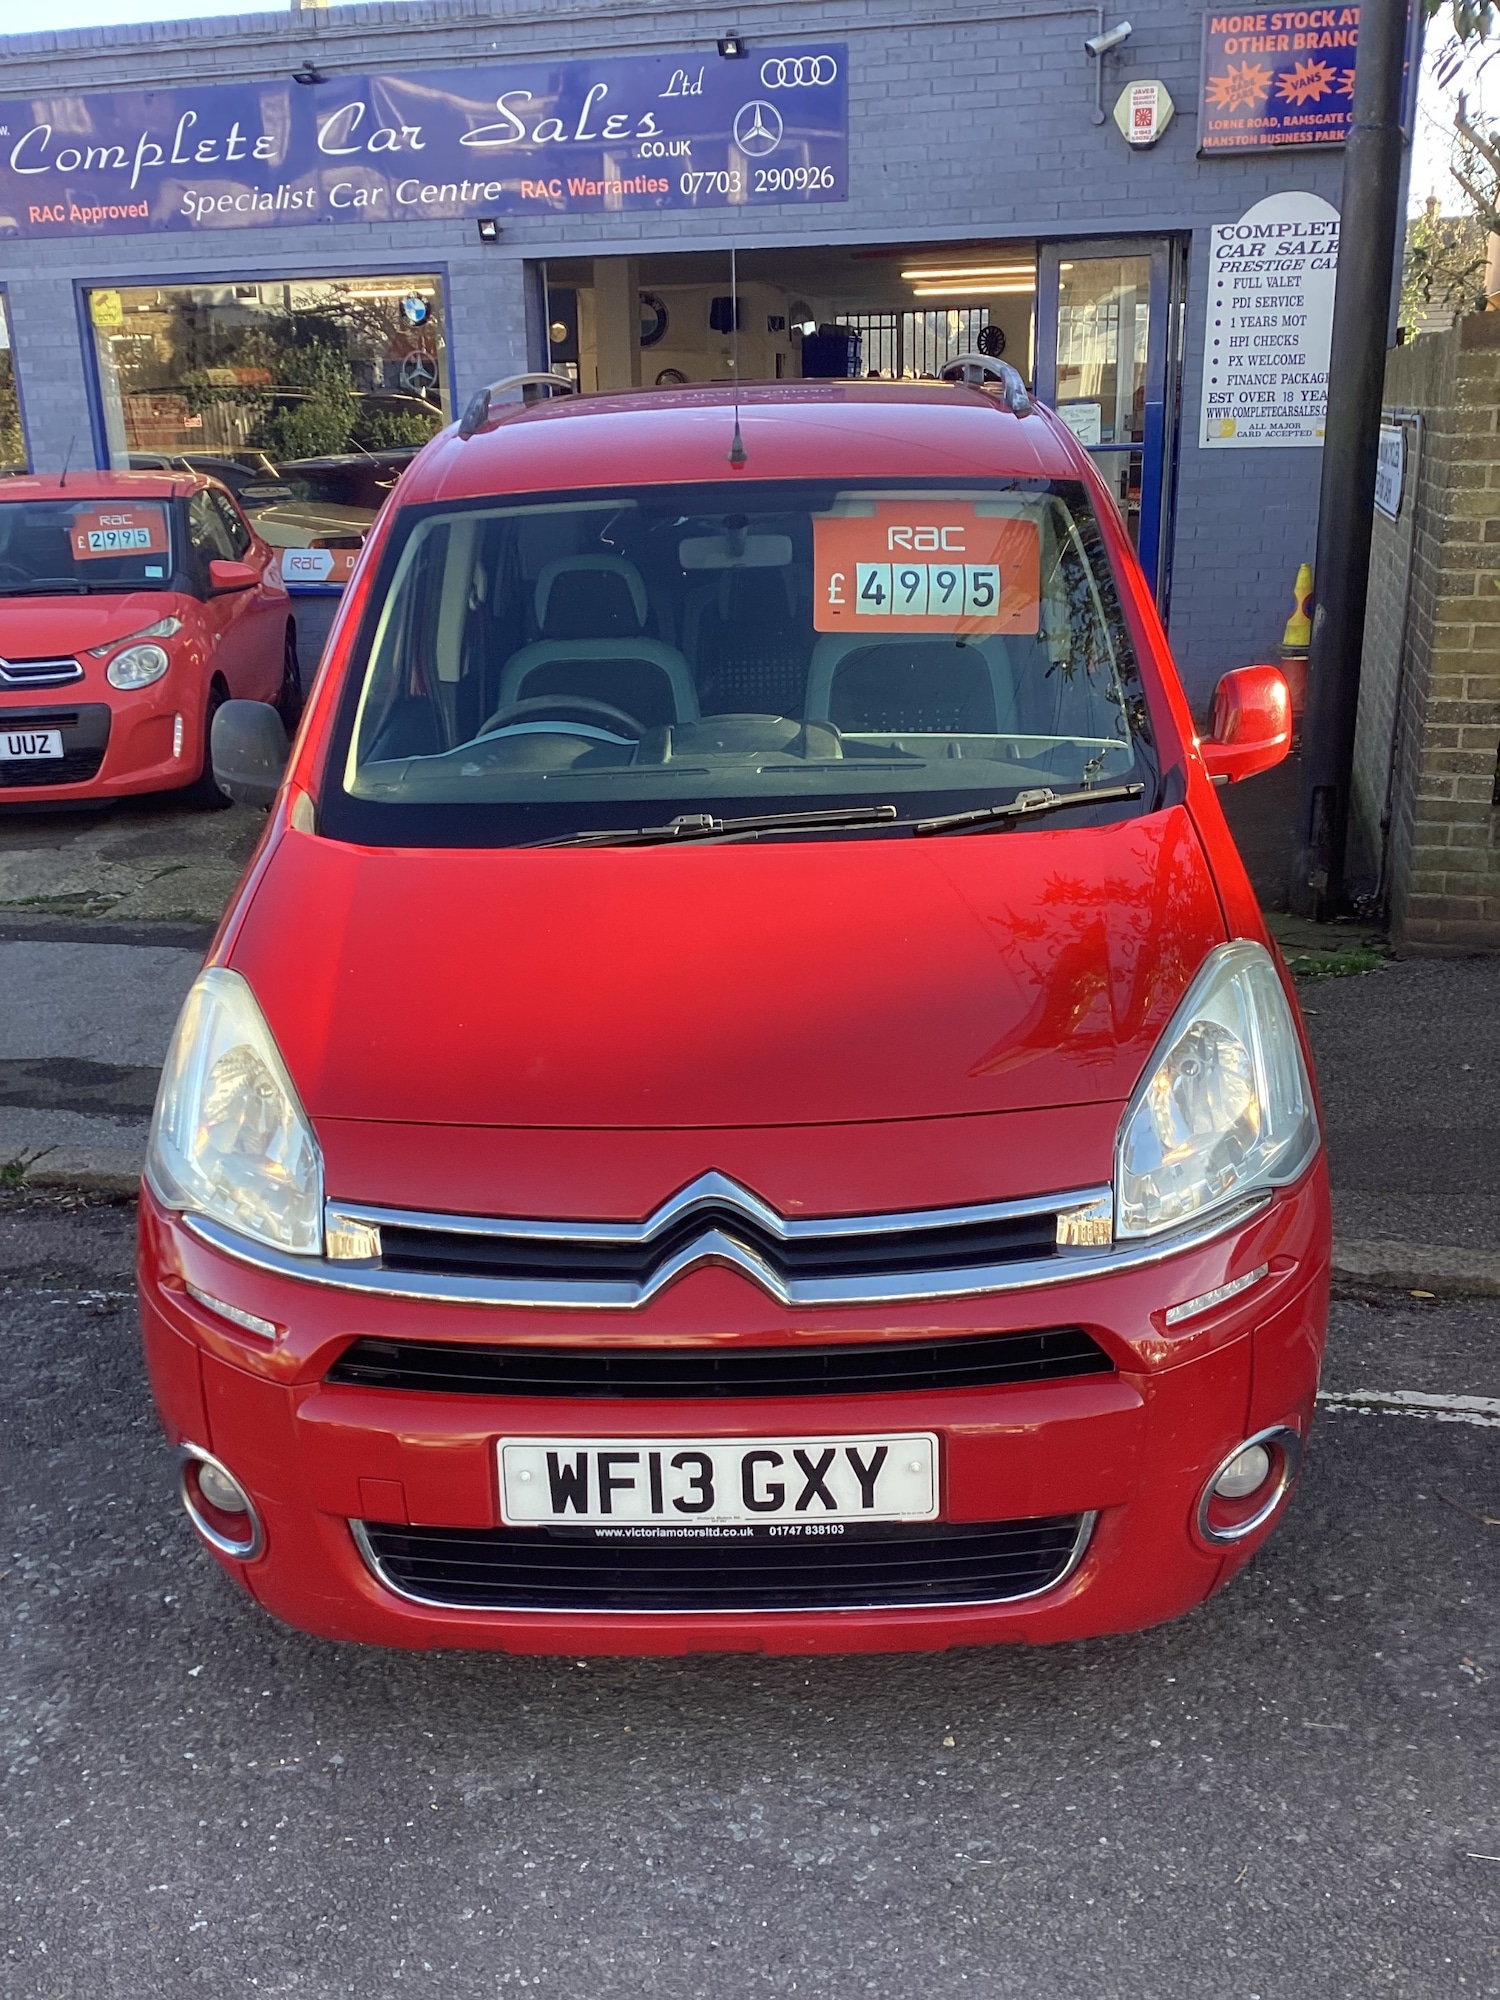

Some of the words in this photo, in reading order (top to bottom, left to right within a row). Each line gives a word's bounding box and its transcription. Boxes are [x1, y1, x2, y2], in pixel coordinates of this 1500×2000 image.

[1210, 14, 1267, 34] MORE
[1271, 9, 1336, 31] STOCK
[1339, 7, 1360, 26] AT
[1224, 34, 1290, 55] OTHER
[658, 66, 705, 98] Ltd
[1291, 72, 1322, 91] VANS
[1208, 119, 1245, 130] LORNE
[1247, 117, 1280, 129] ROAD,
[1283, 113, 1344, 126] RAMSGATE
[10, 110, 277, 189] Complete
[317, 102, 427, 155] Car
[459, 83, 664, 146] Sales
[1203, 135, 1258, 147] MANSTON
[1260, 132, 1313, 144] BUSINESS
[1315, 130, 1345, 141] PARK
[636, 140, 692, 158] .CO.UK
[520, 180, 562, 199] RAC
[567, 174, 670, 197] Warranties
[680, 170, 741, 195] 07703
[754, 166, 835, 192] 290926
[180, 185, 315, 220] Specialist
[329, 183, 383, 208] Car
[395, 178, 502, 205] Centre
[29, 205, 65, 223] RAC
[69, 201, 149, 223] Approved
[1220, 221, 1340, 240] COMPLET
[1216, 243, 1266, 259] CAR
[1275, 240, 1339, 256] SALE
[1217, 259, 1305, 273] PRESTIGE
[1233, 277, 1262, 289] FULL
[1267, 276, 1301, 288] VALET
[1232, 297, 1251, 308] PDI
[1255, 295, 1304, 308] SERVICE
[1230, 317, 1236, 328] 1
[1240, 316, 1277, 328] YEARS
[1282, 315, 1307, 326] MOT
[1229, 336, 1249, 347] HPI
[1253, 335, 1299, 347] CHECKS
[1228, 355, 1244, 366] PX
[1248, 354, 1306, 366] WELCOME
[1227, 374, 1277, 386] FINANCE
[1208, 392, 1234, 404] EST
[1239, 391, 1276, 403] OVER
[1283, 391, 1294, 402] 18
[1300, 390, 1329, 402] YEA
[1237, 430, 1261, 438] CARD
[1265, 430, 1312, 438] ACCEPTED
[90, 530, 147, 548] 2995
[346, 556, 355, 568] D
[828, 572, 845, 604] £
[861, 570, 994, 607] 4995
[8, 735, 51, 755] UUZ
[546, 1451, 715, 1514] WF13
[741, 1446, 888, 1512] GXY
[595, 1527, 754, 1537] www.victoriamotorsltd.co.uk
[769, 1526, 802, 1536] 01747
[805, 1525, 845, 1535] 838103
